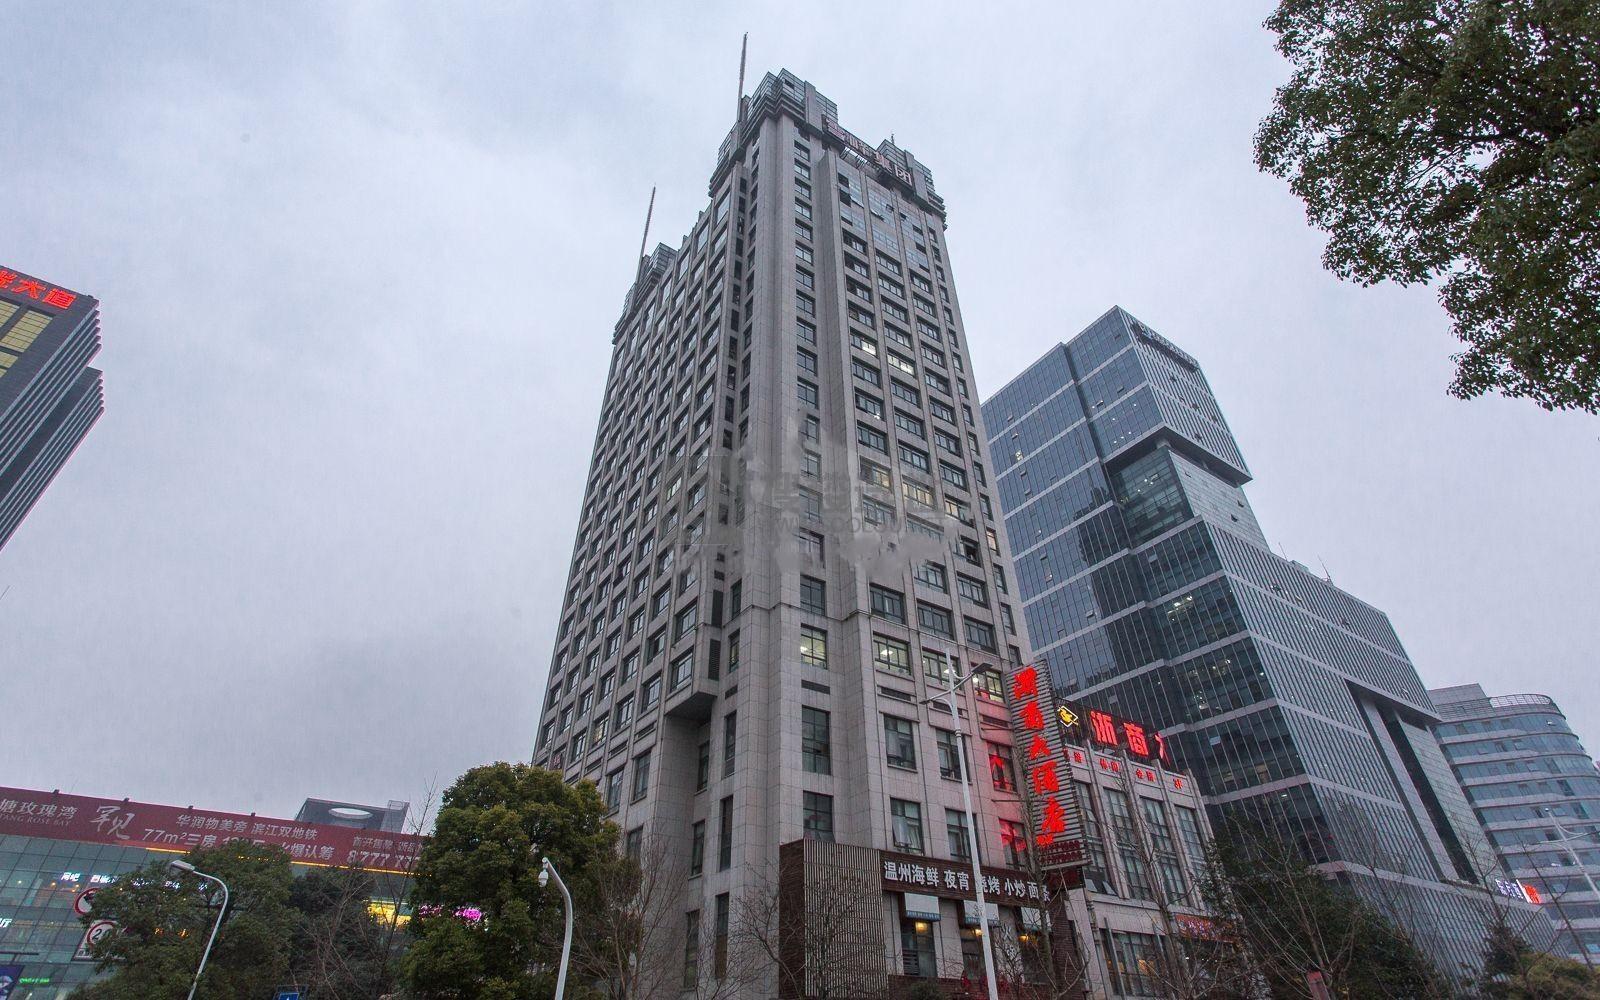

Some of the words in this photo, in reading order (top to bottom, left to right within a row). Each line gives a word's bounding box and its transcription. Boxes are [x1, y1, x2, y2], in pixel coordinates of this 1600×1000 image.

[176, 813, 248, 833] 华润物美旁
[251, 822, 318, 840] 滨江双地铁
[884, 861, 940, 888] 温州海鲜
[943, 869, 970, 892] 夜宵
